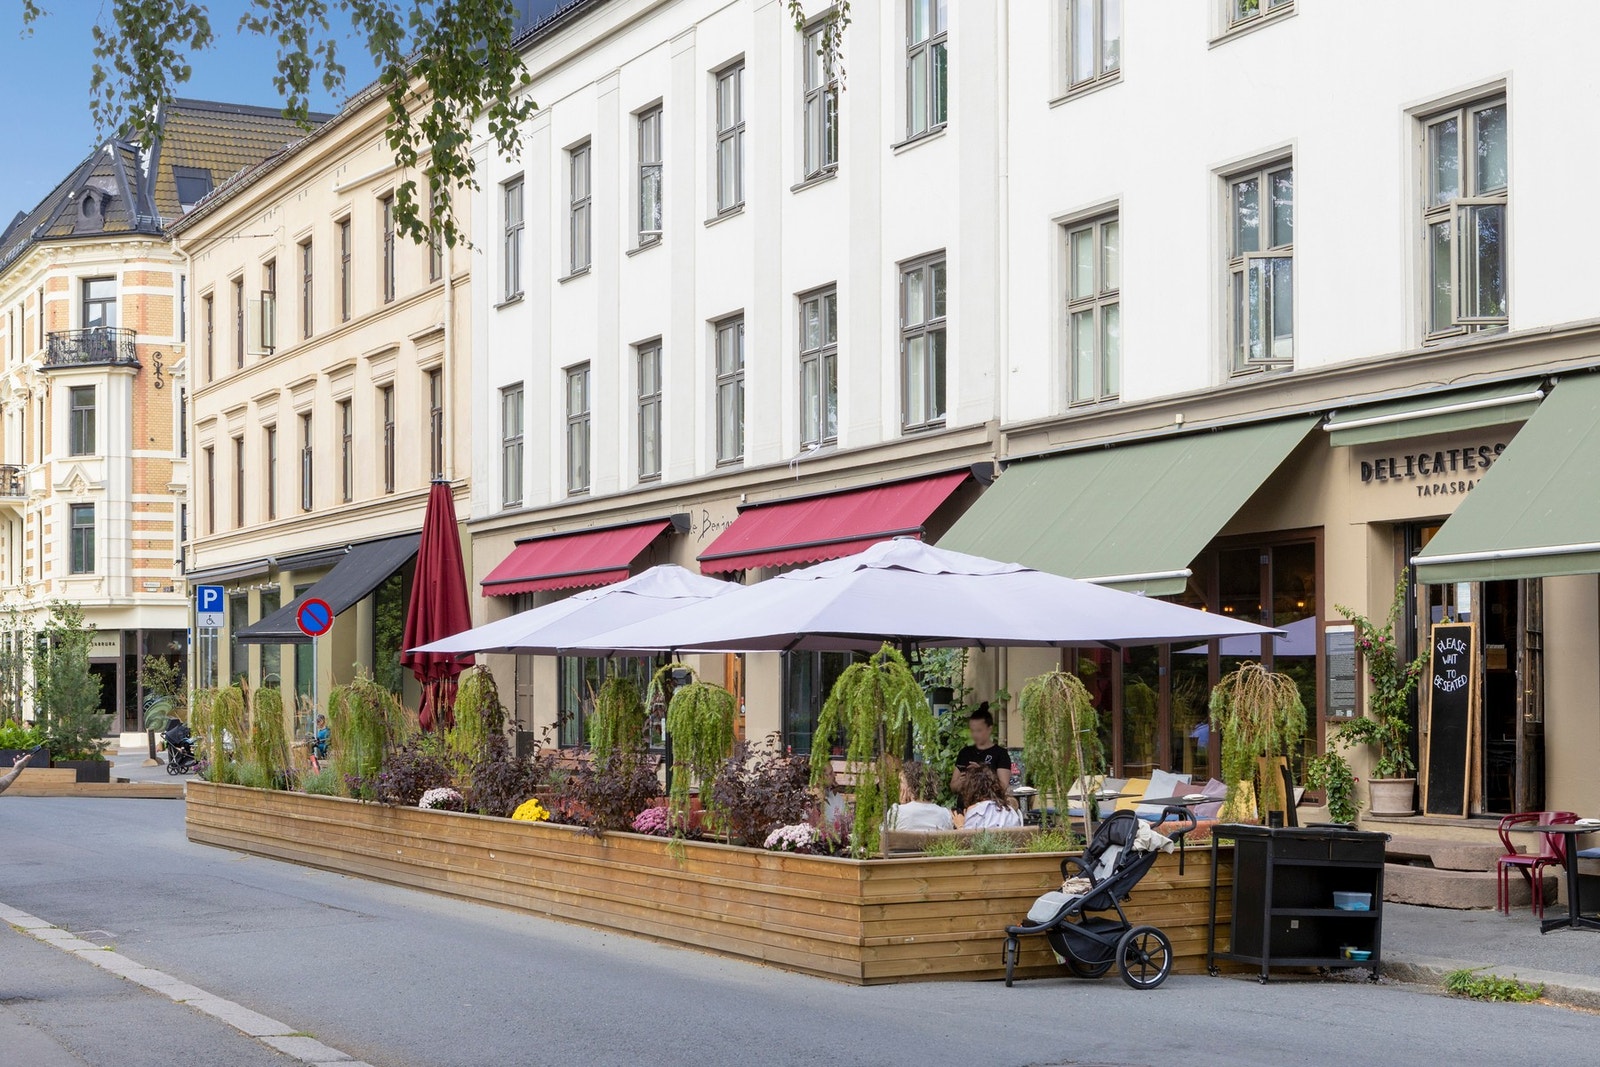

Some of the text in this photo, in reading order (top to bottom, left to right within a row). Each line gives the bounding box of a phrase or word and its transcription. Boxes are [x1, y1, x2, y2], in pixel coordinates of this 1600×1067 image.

[1416, 478, 1481, 497] TAPASBA
[204, 589, 218, 609] P
[1437, 638, 1467, 654] PLEASE
[1446, 669, 1456, 679] TO
[1434, 675, 1468, 692] BE SEATED
